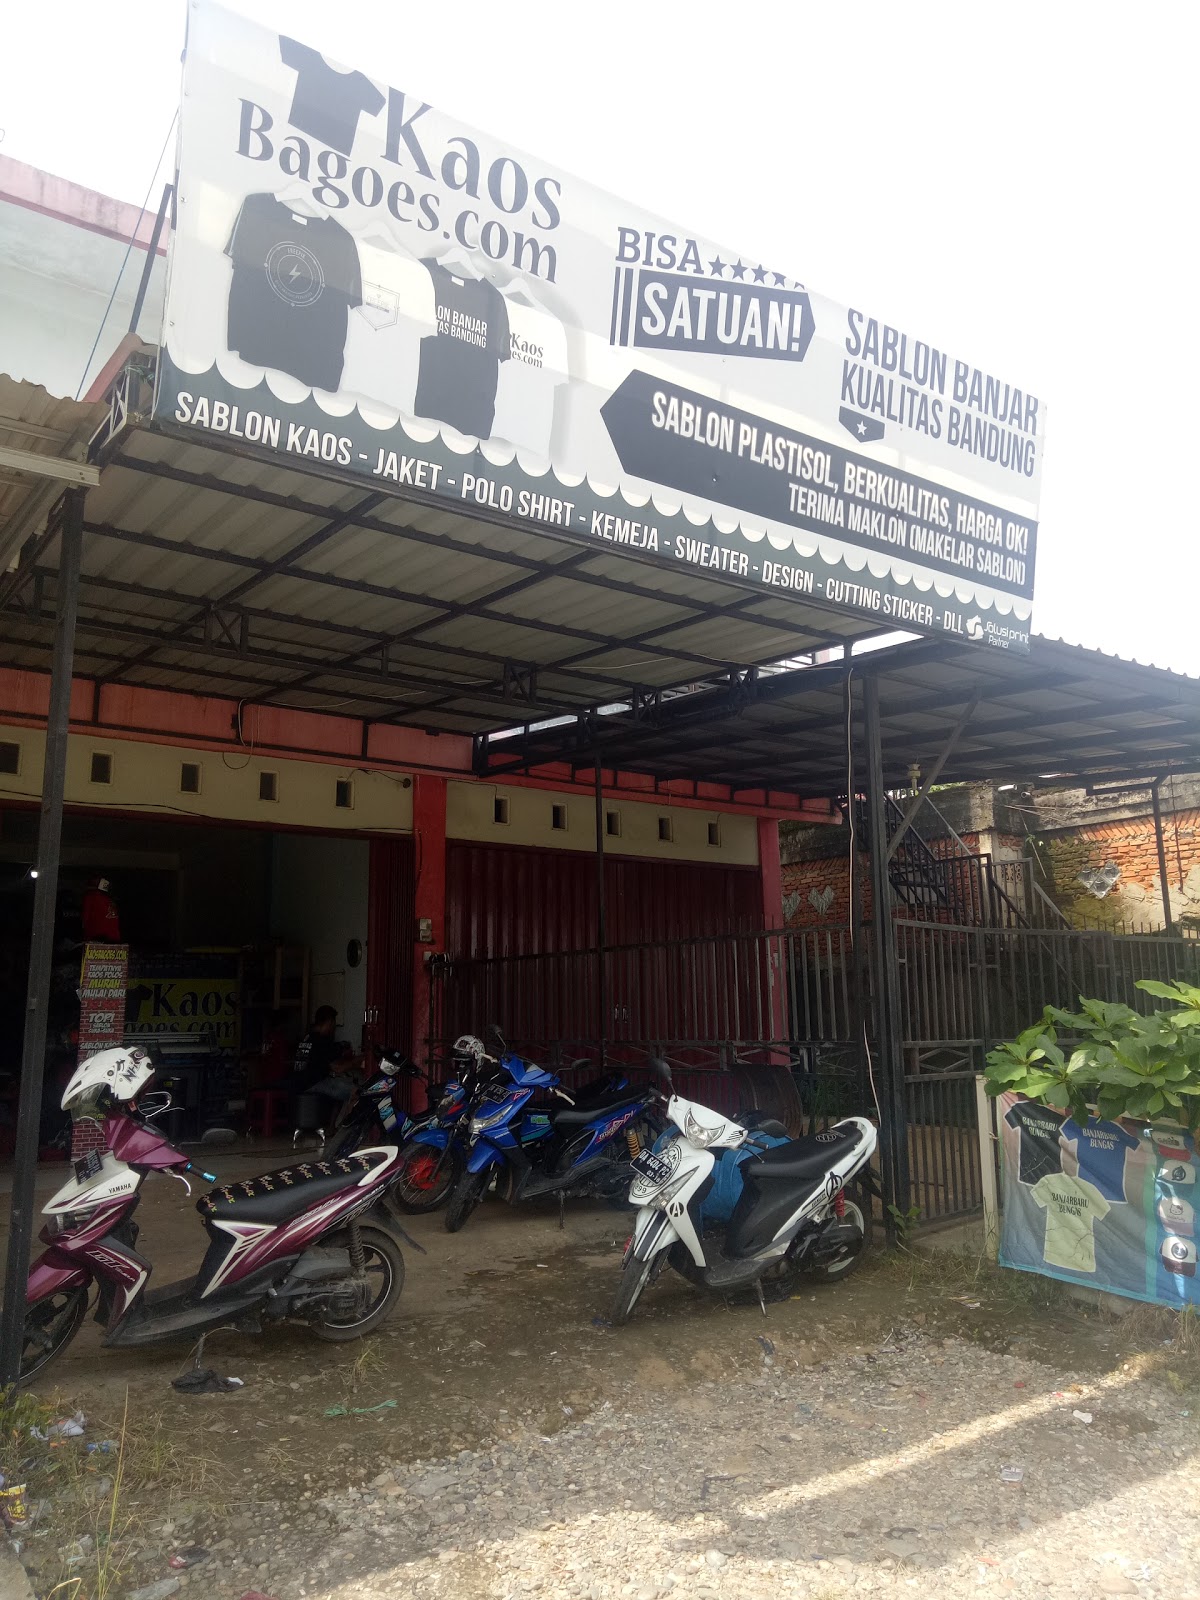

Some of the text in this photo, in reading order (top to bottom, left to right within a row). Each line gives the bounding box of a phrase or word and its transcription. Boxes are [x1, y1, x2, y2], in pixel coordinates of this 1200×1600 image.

[380, 86, 562, 231] Kaos
[235, 98, 558, 284] Bagoes.com
[615, 226, 704, 275] BISA
[452, 310, 488, 336] BANJAR
[641, 281, 803, 353] SATUAN!
[450, 325, 487, 349] BANDUNG
[511, 332, 544, 358] Kaos
[845, 307, 1039, 437] SABLON BANJAR
[840, 358, 1036, 478] KUALITAS BANDUNG
[651, 391, 1029, 556] SABLON PLASTISOL, BERKUALITAS, HARGA OK!
[174, 391, 281, 448] SABLON
[286, 422, 354, 466] KAOS
[372, 448, 443, 491] JAKET
[460, 472, 513, 512] POLO
[517, 490, 575, 527] SHIRT
[590, 510, 659, 552] KEMEJA
[674, 535, 749, 577] SWEATER
[761, 560, 815, 594] DESIGN
[825, 577, 881, 611] CUTTING
[883, 593, 934, 626] STICKER
[942, 610, 964, 635] DLL
[788, 482, 1027, 586] TERIMA MAKLON (MAKELAR SABLON)
[988, 634, 1010, 649] Partner
[82, 989, 127, 998] MULAI DARI
[88, 979, 120, 989] MURAH
[152, 983, 238, 1017] Kaos
[89, 1012, 115, 1023] TOPI
[1090, 1138, 1115, 1151] BUNGAS
[108, 1182, 132, 1194] YAMAHA
[1051, 1192, 1090, 1209] BANJARBARU
